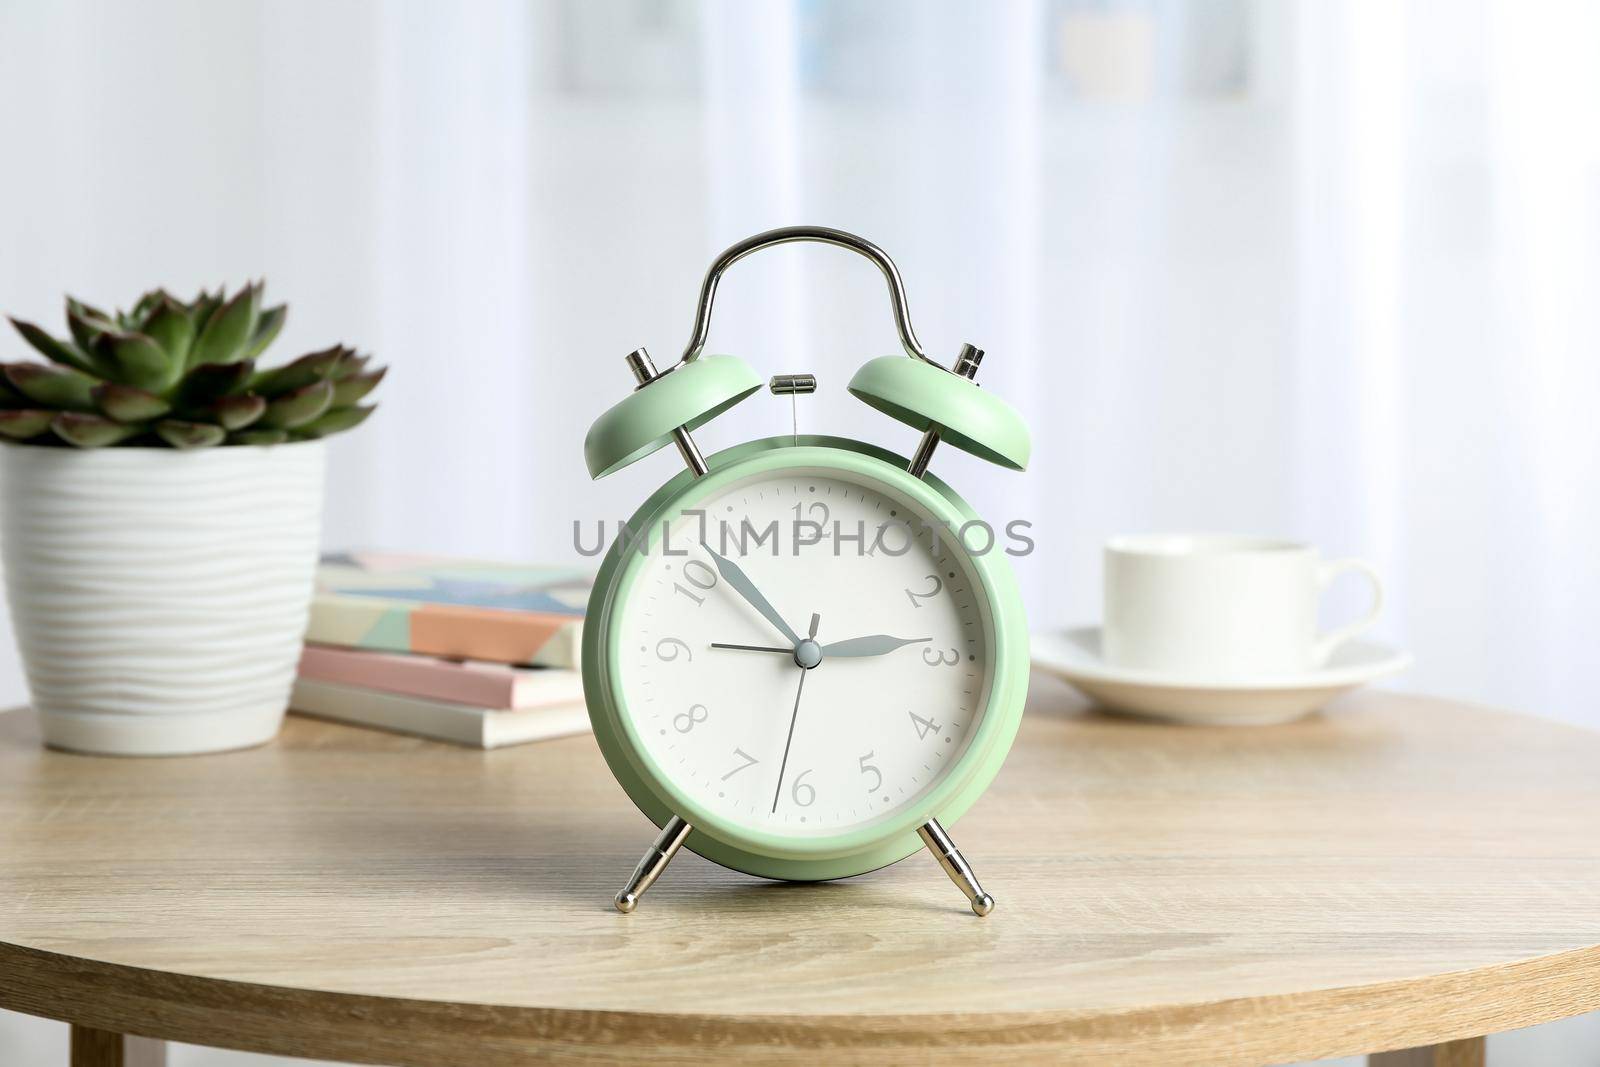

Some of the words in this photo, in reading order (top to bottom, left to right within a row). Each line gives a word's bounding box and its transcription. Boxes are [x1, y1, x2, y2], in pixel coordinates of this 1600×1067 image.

[792, 501, 831, 539] 12
[673, 559, 718, 607] 10
[904, 574, 943, 609] 2
[656, 637, 692, 662] 9
[922, 647, 960, 667] 3
[673, 703, 708, 734] 8
[908, 711, 942, 741] 4
[716, 747, 760, 782] 7
[859, 750, 882, 794] 5
[791, 768, 817, 807] 6
